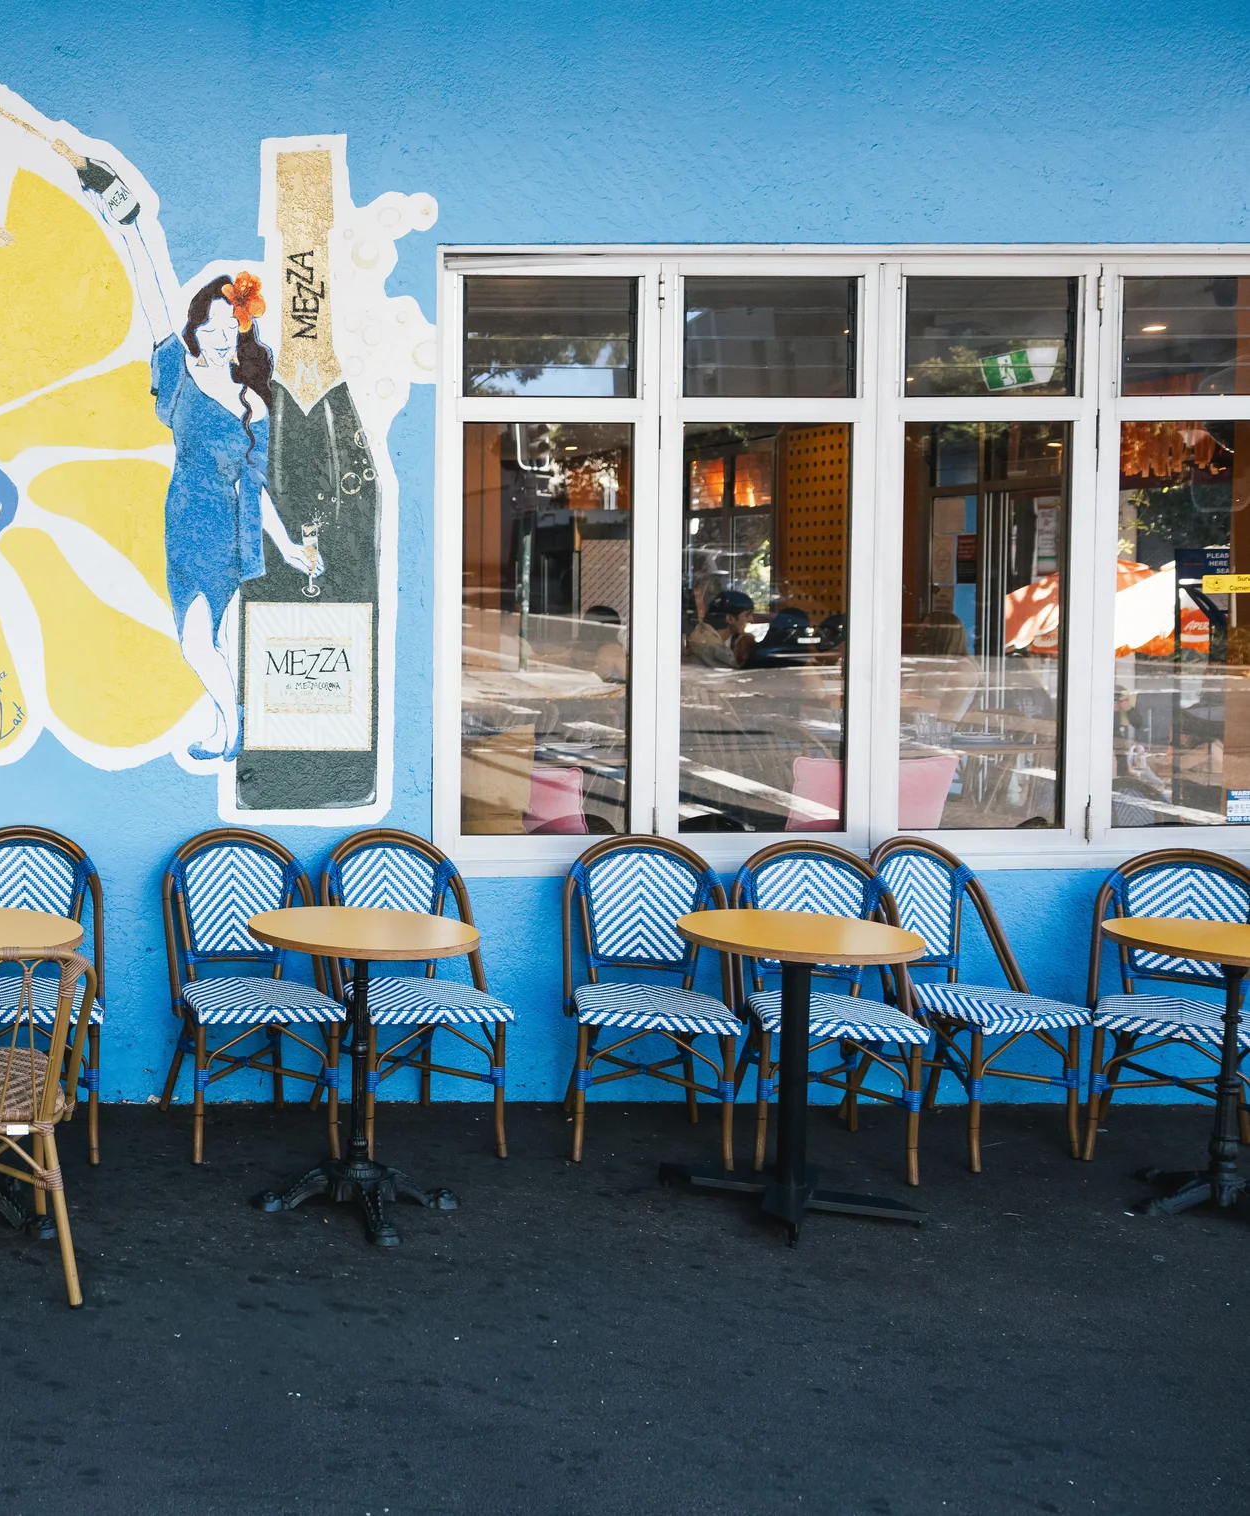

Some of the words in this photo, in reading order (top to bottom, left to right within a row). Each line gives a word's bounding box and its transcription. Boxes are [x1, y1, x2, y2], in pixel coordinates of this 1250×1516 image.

[108, 186, 130, 211] MEZZA
[287, 250, 325, 340] MEZZA
[265, 647, 351, 680] MEZZA
